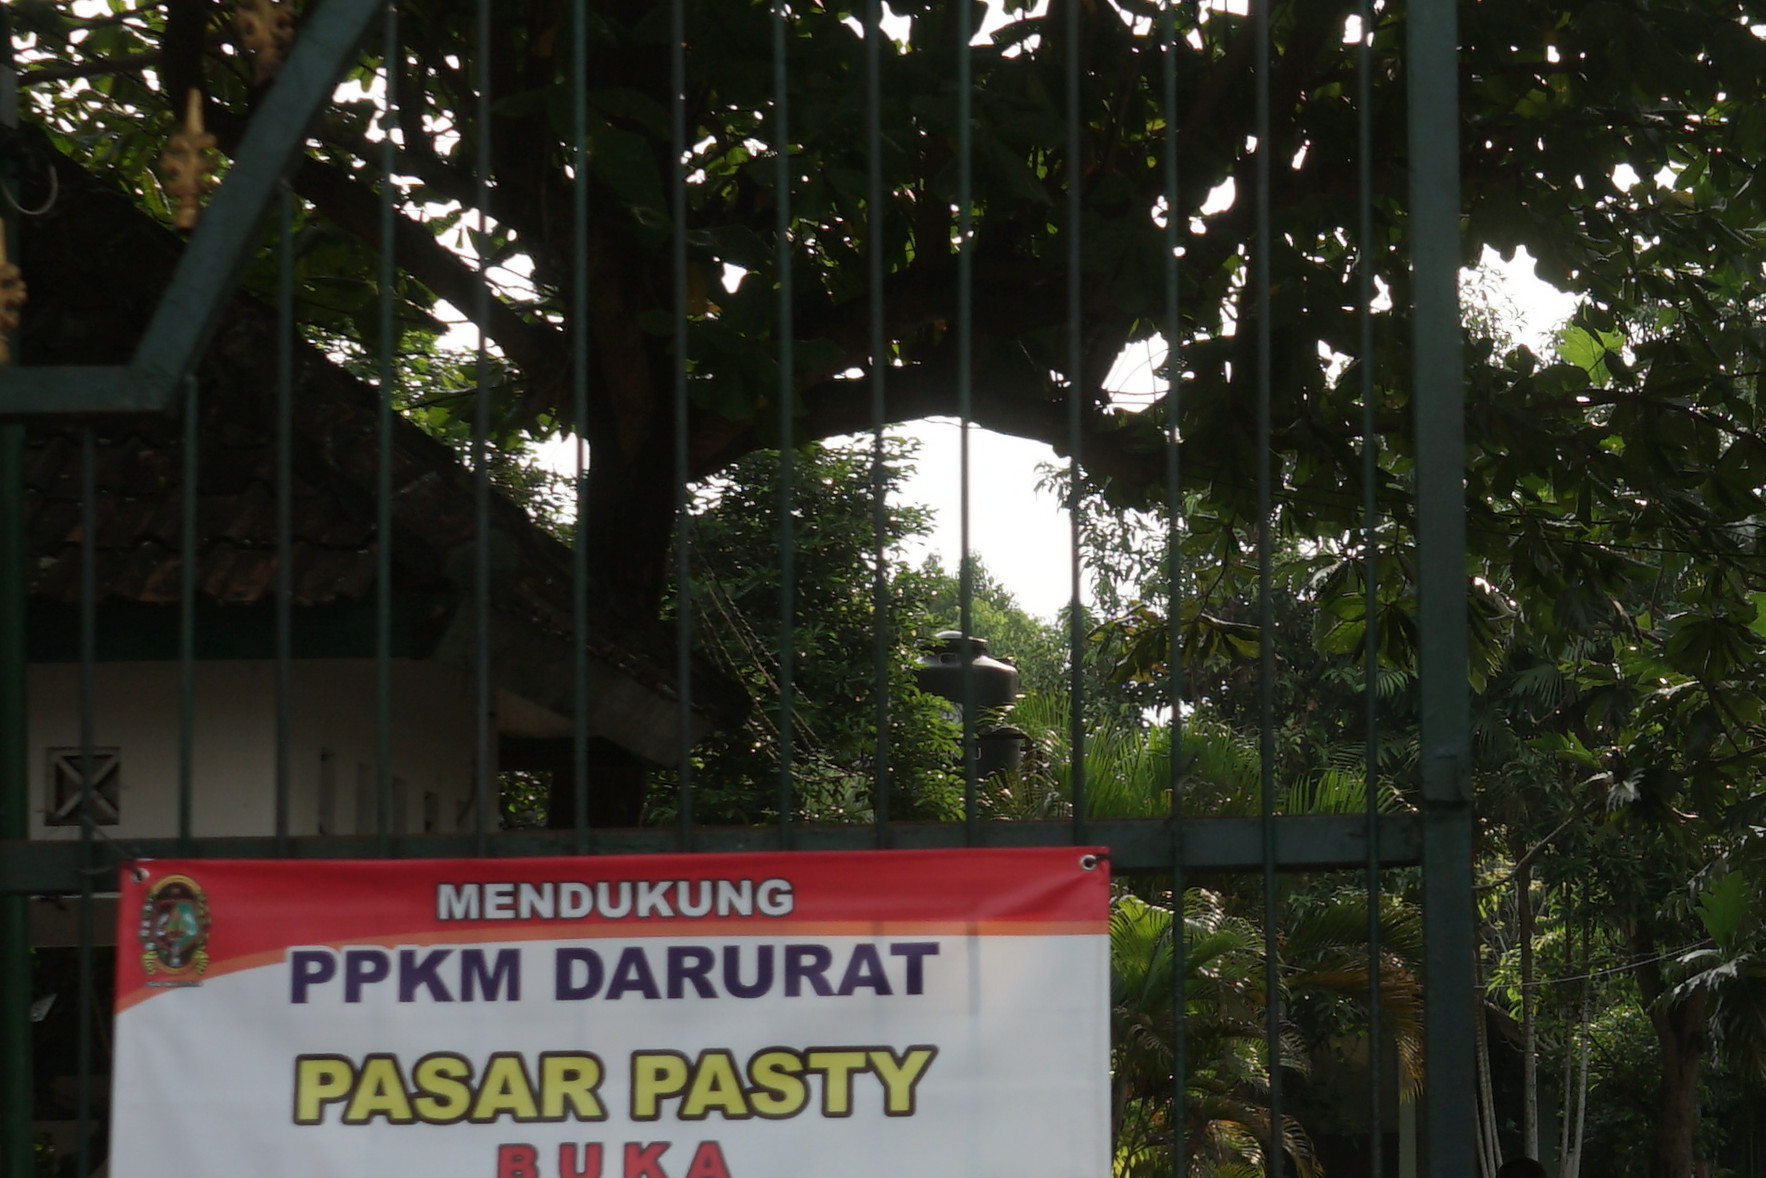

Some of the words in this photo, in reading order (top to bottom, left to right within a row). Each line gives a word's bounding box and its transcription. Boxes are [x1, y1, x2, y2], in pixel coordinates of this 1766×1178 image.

[437, 878, 794, 921] MENDUKUNG
[290, 947, 522, 1004] PPKM
[555, 942, 940, 1001] DARURAT
[292, 1050, 608, 1125] PASAR
[629, 1043, 939, 1123] PASTY
